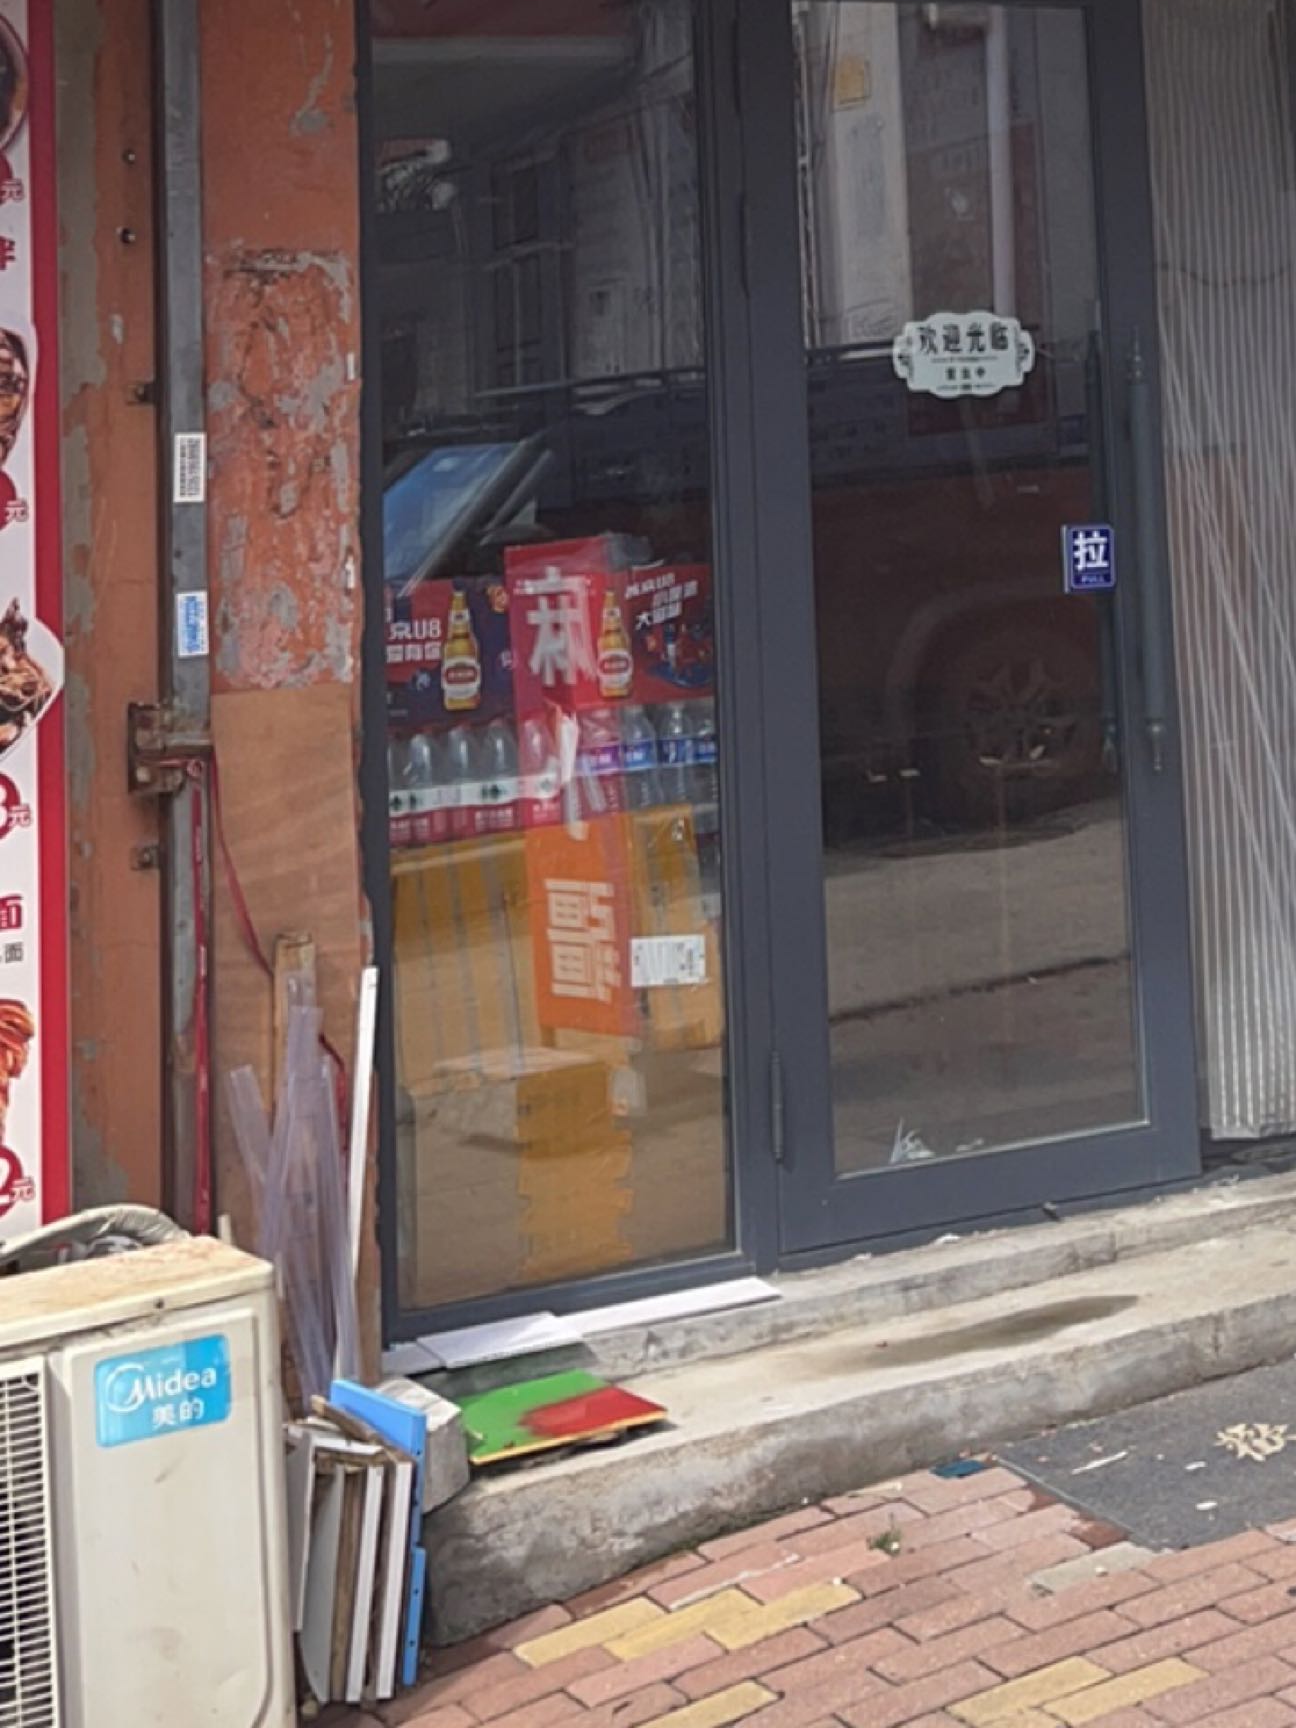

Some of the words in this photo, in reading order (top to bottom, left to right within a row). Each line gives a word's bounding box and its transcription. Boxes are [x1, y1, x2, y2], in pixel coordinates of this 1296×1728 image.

[916, 321, 1009, 354] 欢迎光临
[1073, 530, 1109, 571] 拉
[106, 1362, 218, 1413] Midea
[152, 1397, 205, 1430] 美的
